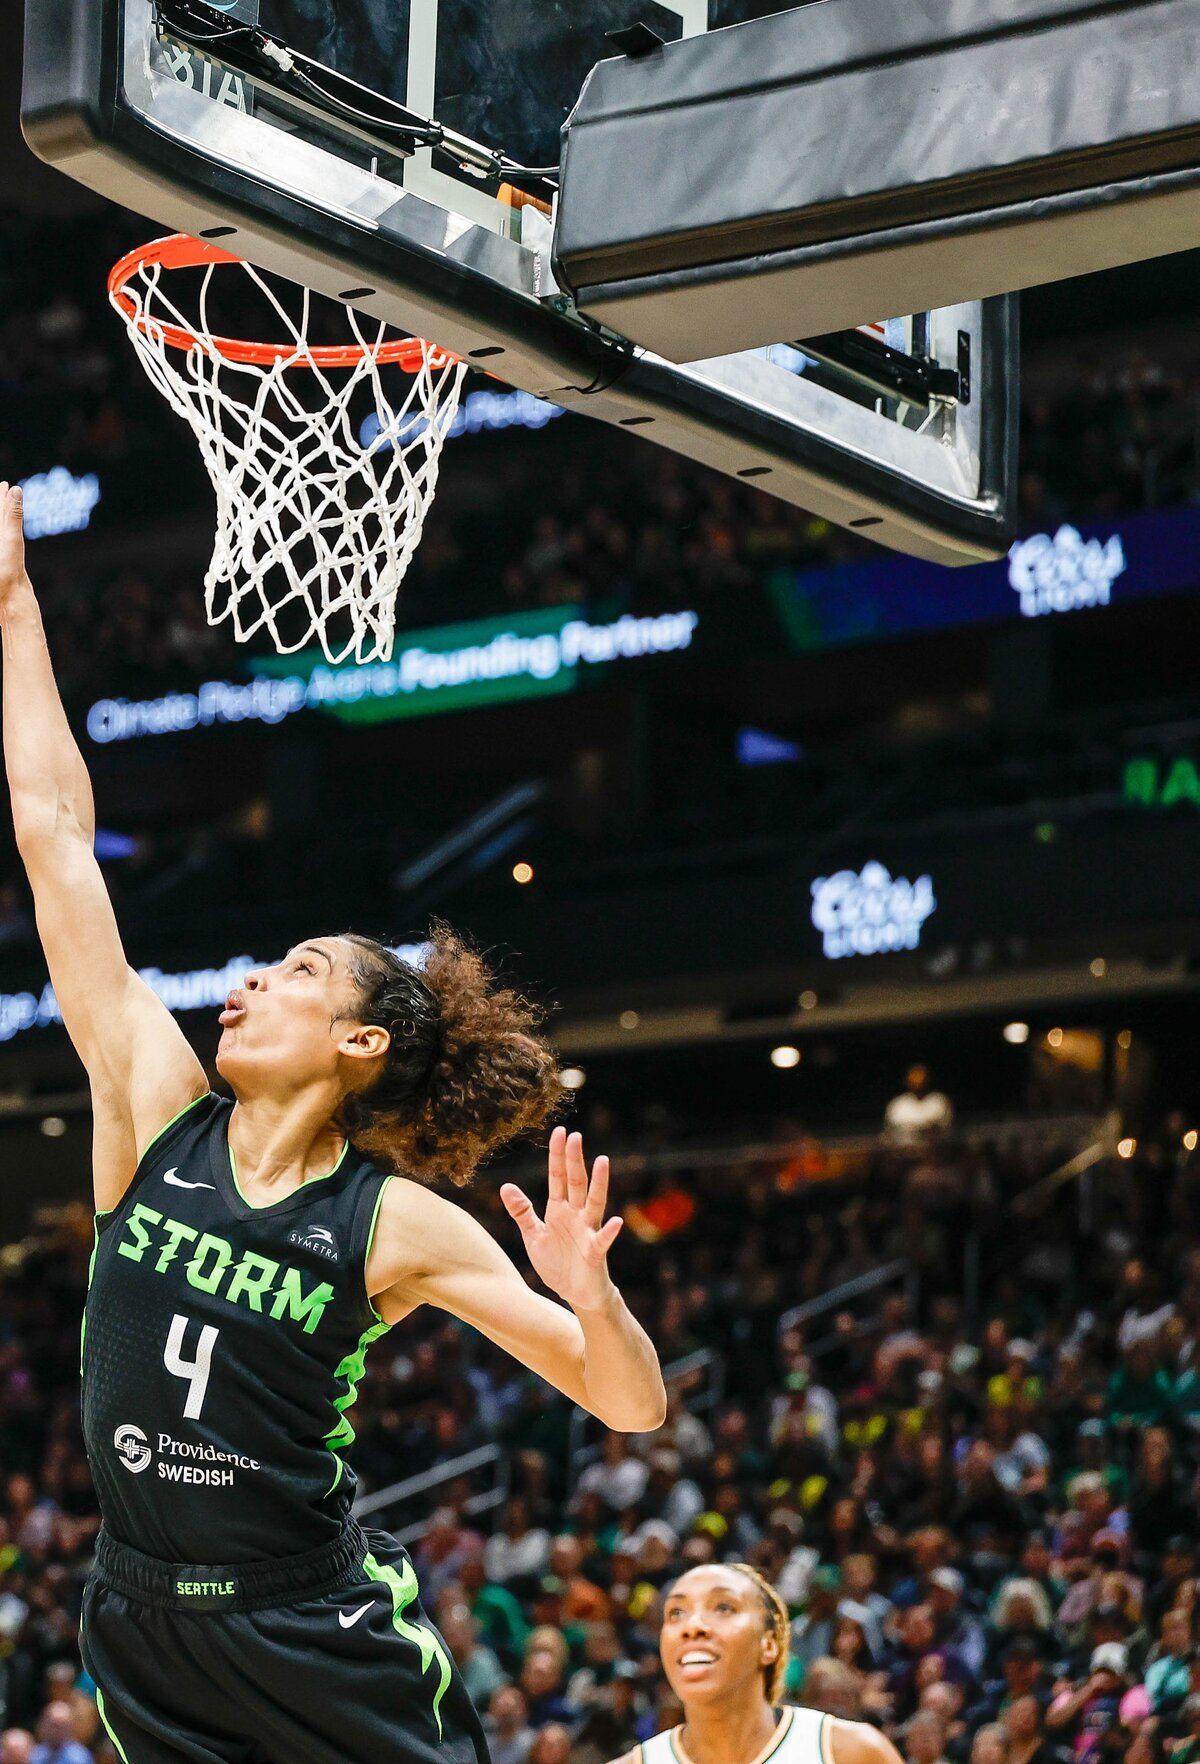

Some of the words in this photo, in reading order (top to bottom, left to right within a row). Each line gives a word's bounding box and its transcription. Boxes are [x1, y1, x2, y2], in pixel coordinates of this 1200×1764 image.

[290, 1233, 338, 1261] SYMETRA
[117, 1202, 334, 1335] STORM
[163, 1313, 219, 1420] 4
[157, 1433, 260, 1470] Providence
[158, 1462, 234, 1486] SWEDISH
[177, 1581, 235, 1596] SEATTLE
